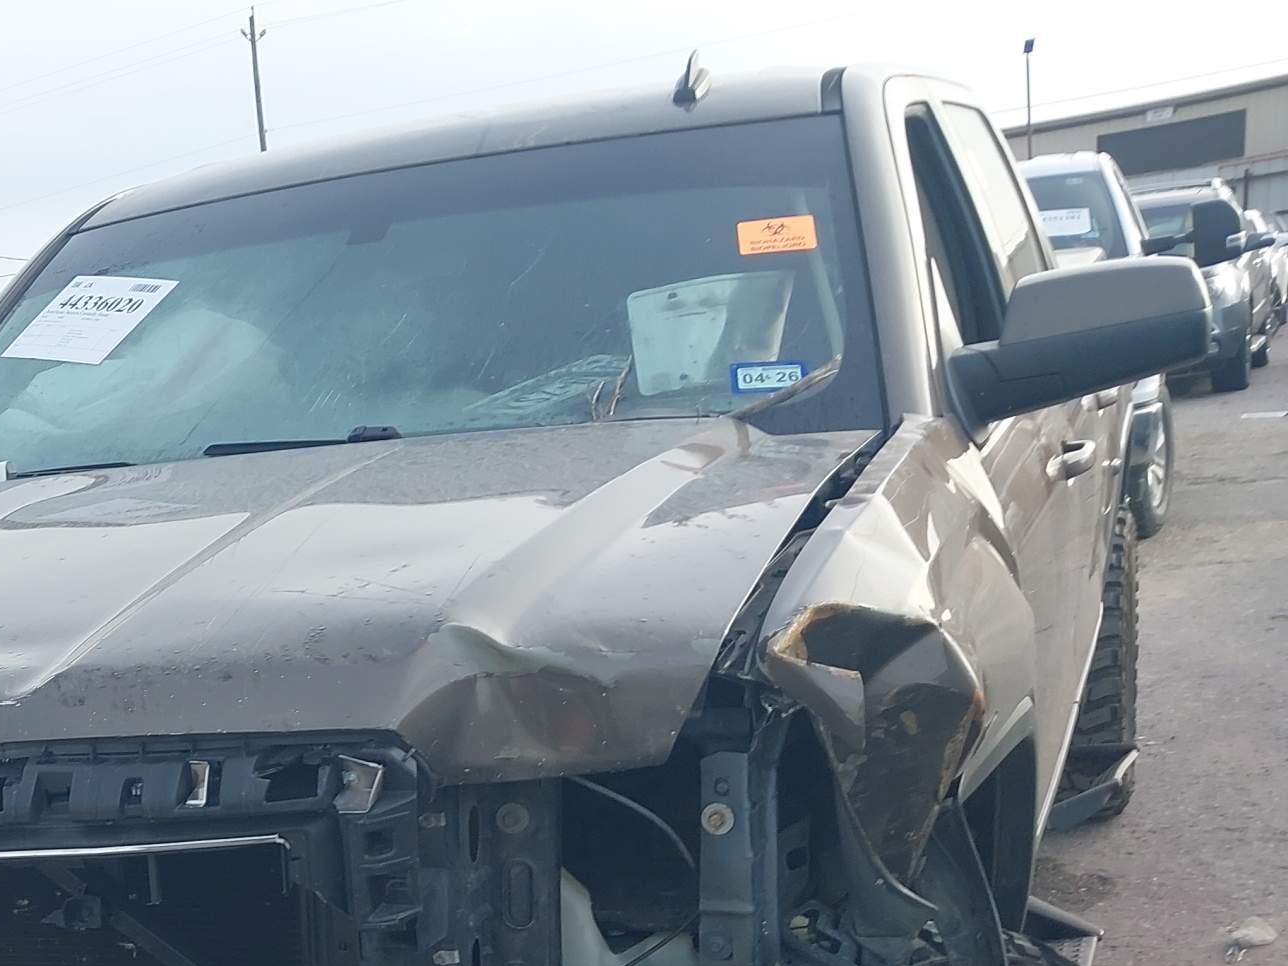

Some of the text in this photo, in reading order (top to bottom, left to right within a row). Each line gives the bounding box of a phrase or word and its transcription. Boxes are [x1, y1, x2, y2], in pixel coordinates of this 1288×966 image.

[59, 295, 143, 313] 44336020
[743, 372, 799, 384] 04 26
